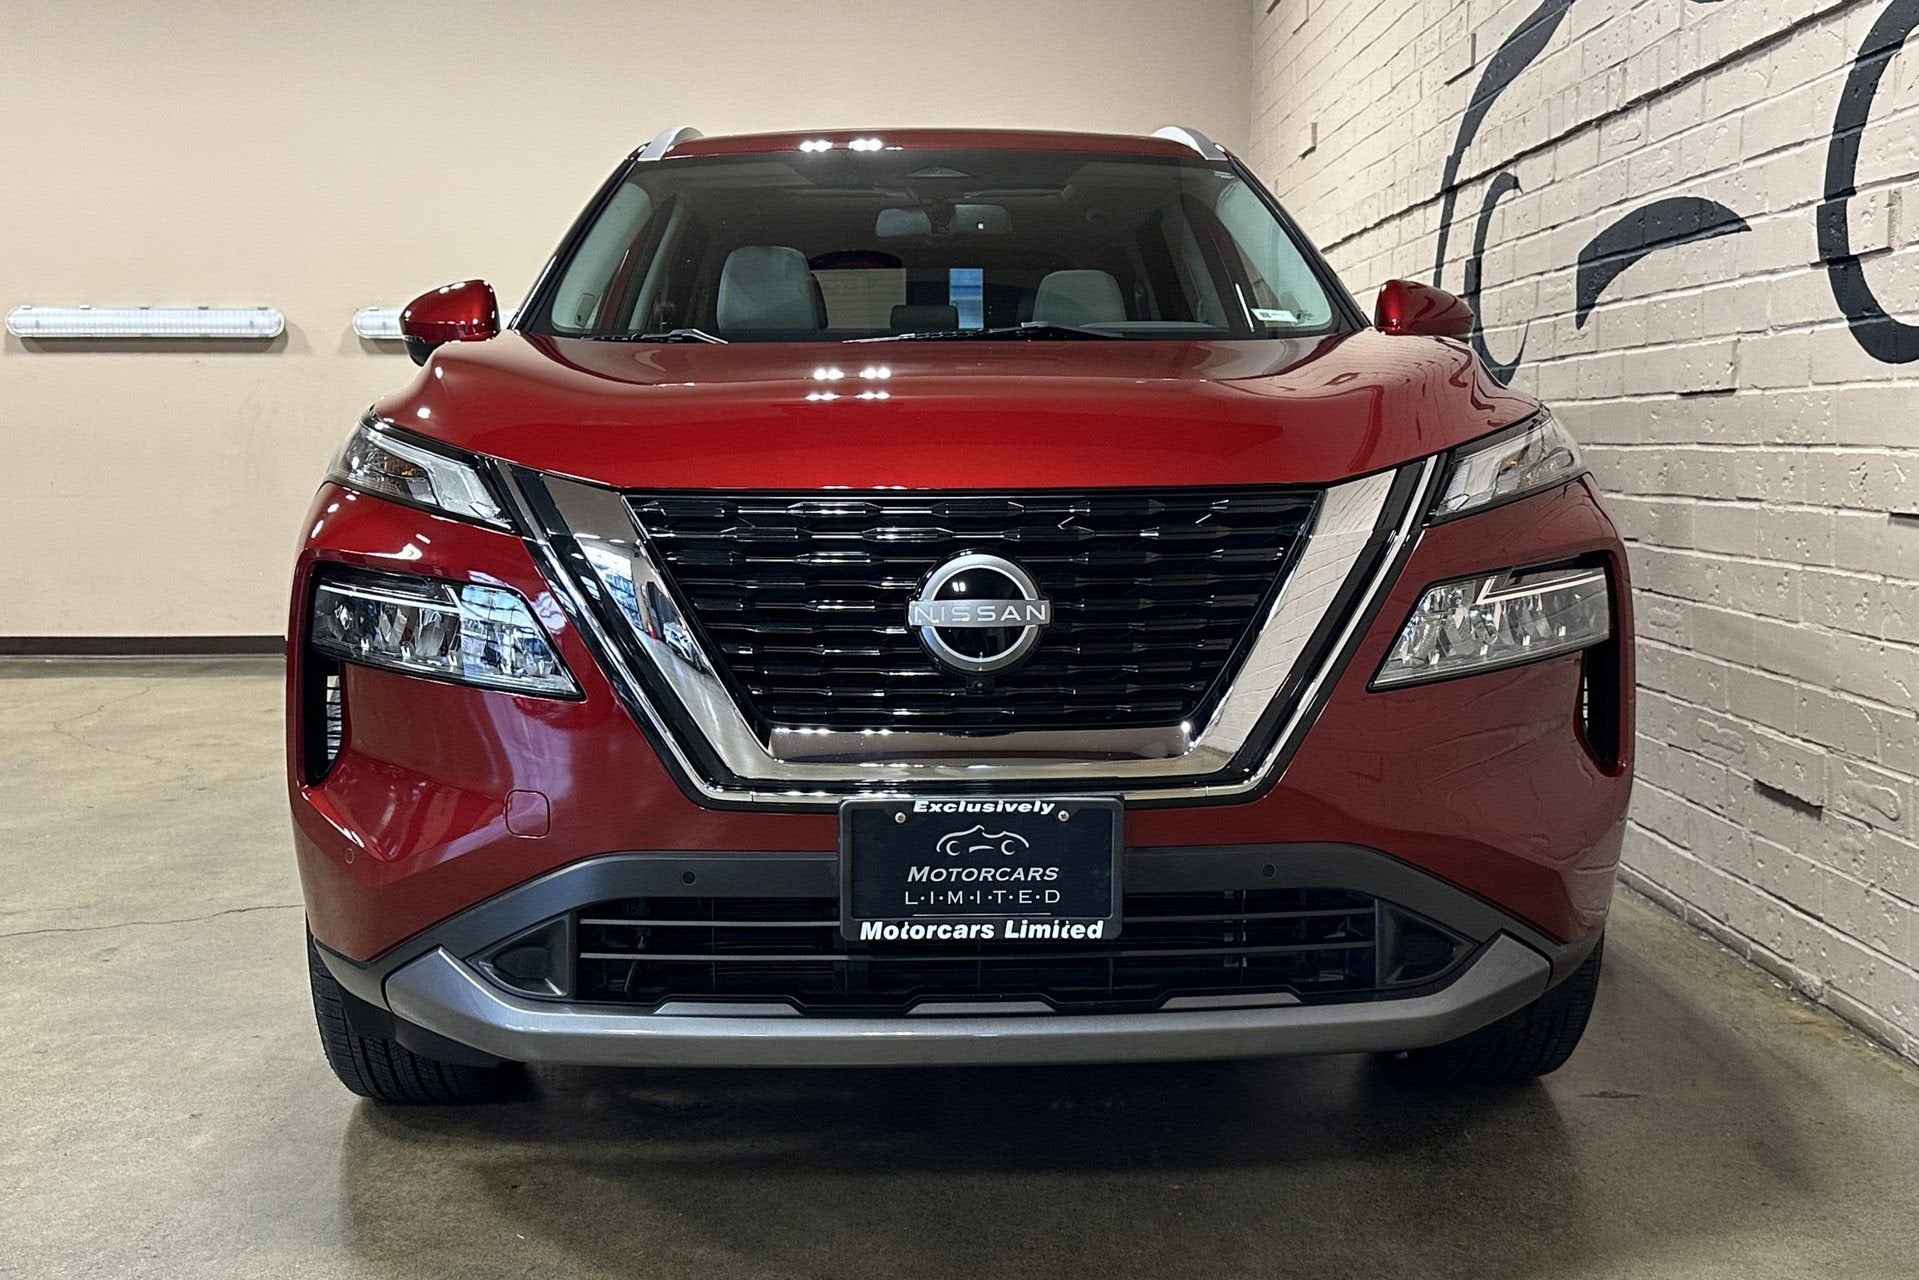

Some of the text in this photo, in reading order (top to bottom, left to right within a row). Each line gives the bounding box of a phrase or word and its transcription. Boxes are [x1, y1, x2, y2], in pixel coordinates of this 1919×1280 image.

[914, 604, 1046, 623] NISSAN
[913, 800, 1055, 814] Exclusively
[907, 866, 1059, 882] MOTORCARS
[860, 919, 1104, 941] Motorcars Limited
